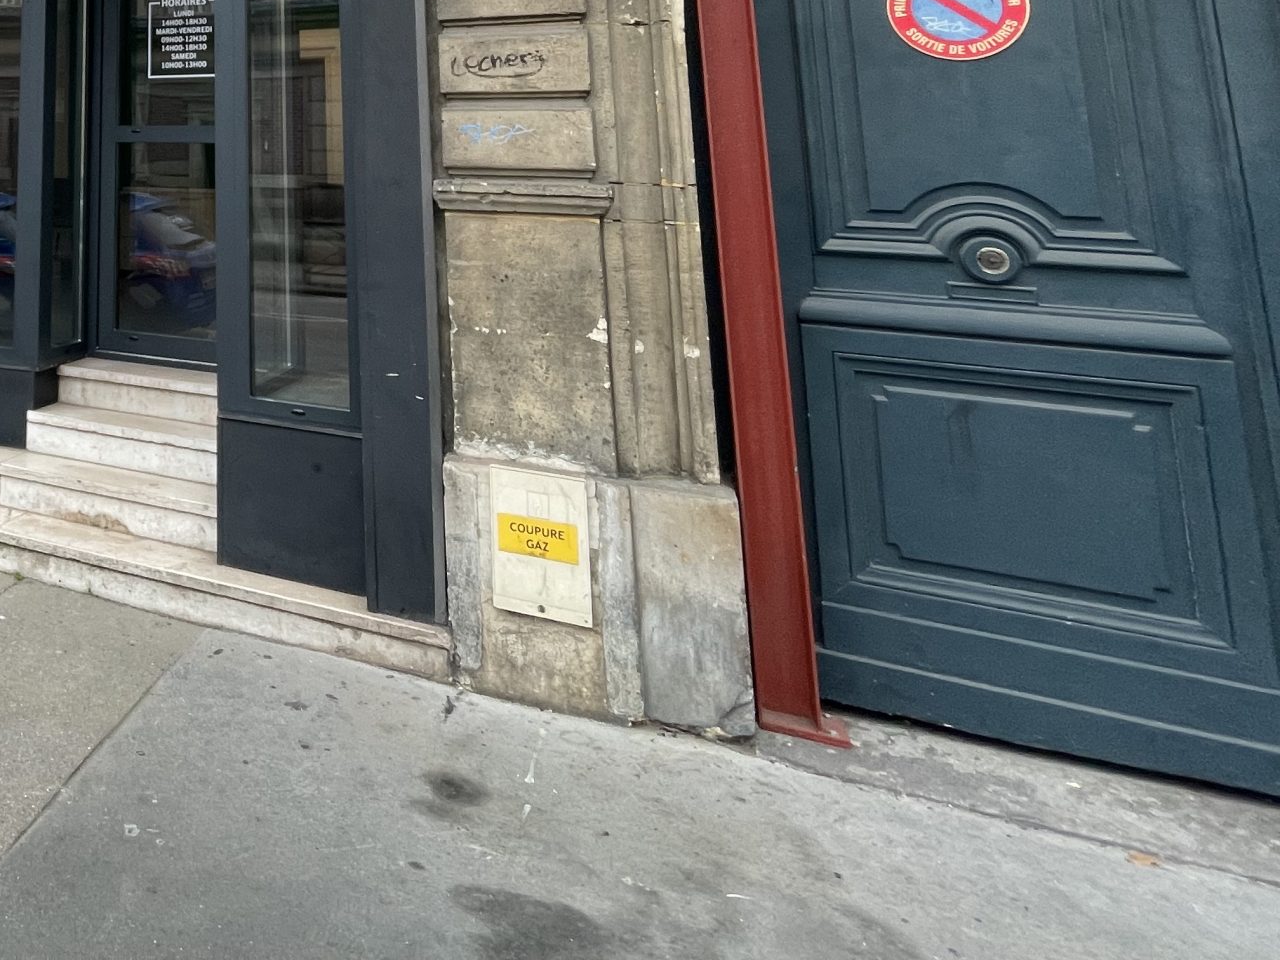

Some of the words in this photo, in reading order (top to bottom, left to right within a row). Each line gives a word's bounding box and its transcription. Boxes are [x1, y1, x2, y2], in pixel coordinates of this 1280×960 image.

[906, 27, 945, 53] SORTIE
[949, 44, 966, 55] DE
[968, 19, 1019, 54] VOITURES
[171, 52, 196, 60] SAMEDI
[509, 522, 565, 541] COUPURE
[526, 539, 549, 552] GAZ
